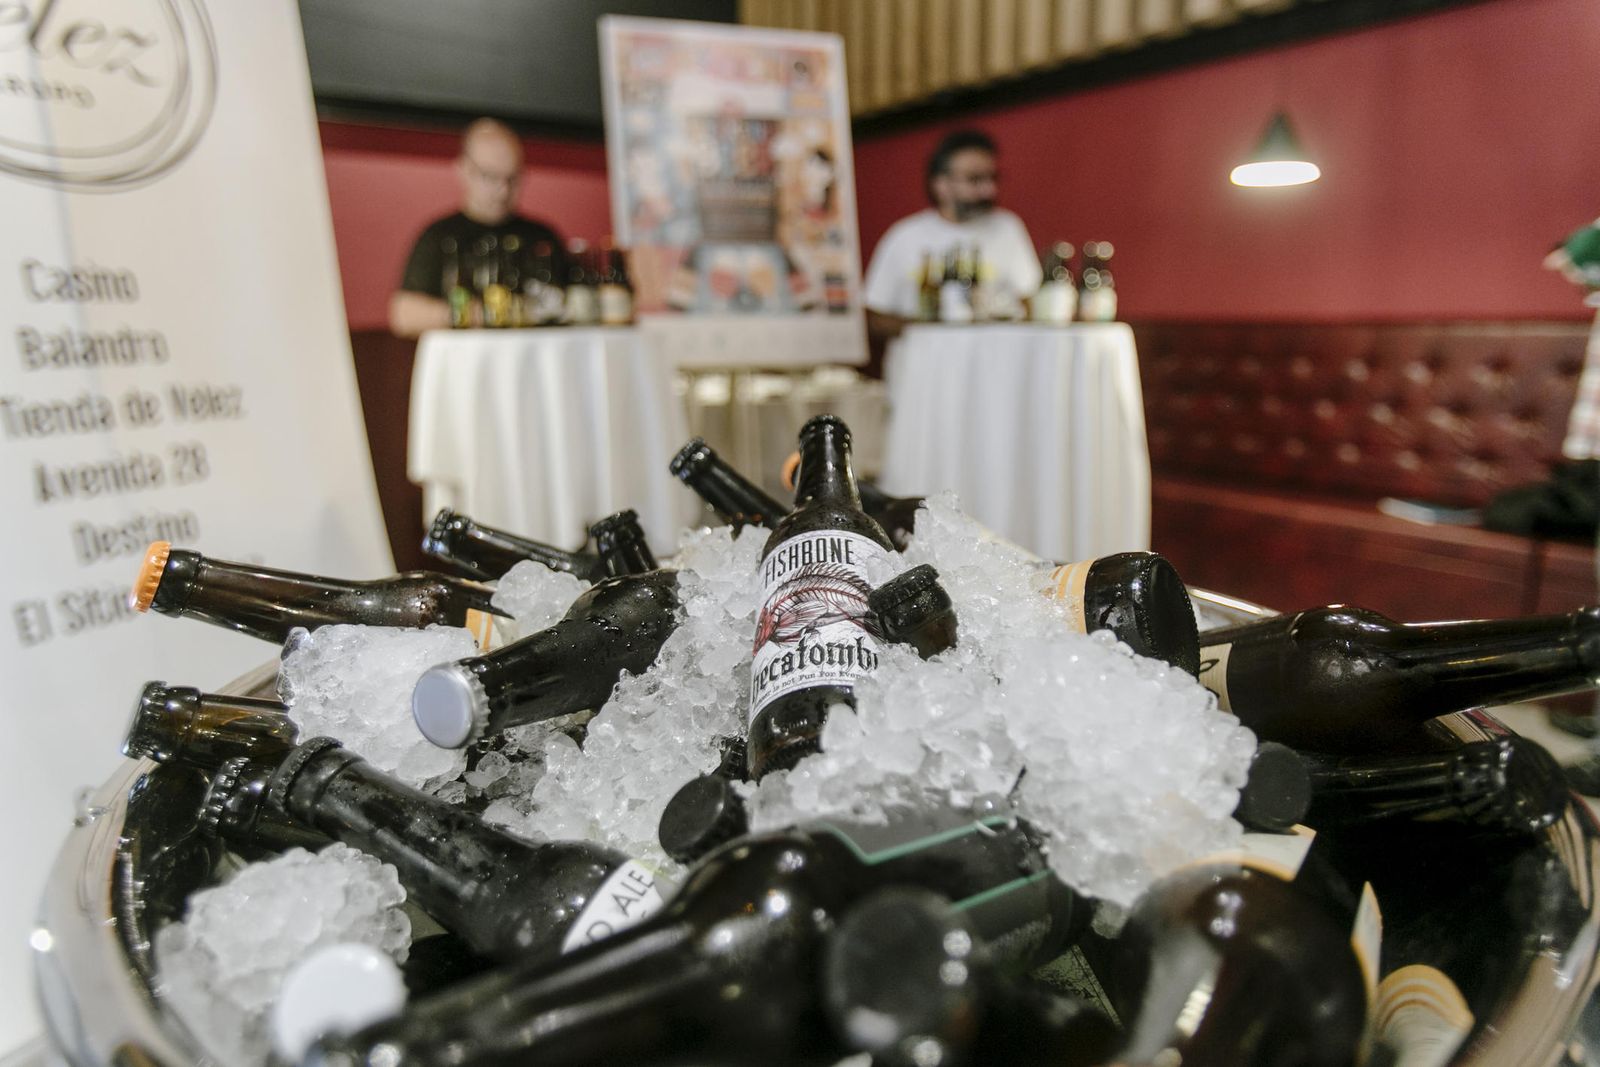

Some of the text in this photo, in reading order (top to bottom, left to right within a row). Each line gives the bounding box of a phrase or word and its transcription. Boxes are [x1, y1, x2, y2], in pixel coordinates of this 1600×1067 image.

[22, 261, 138, 302] Casino
[19, 326, 169, 369] Balandro
[1, 393, 116, 438] Tienda
[121, 386, 163, 429] de
[34, 452, 165, 502] Avenida
[73, 510, 200, 566] Destino
[765, 536, 856, 589] FISHBONE
[611, 870, 655, 918] ALE
